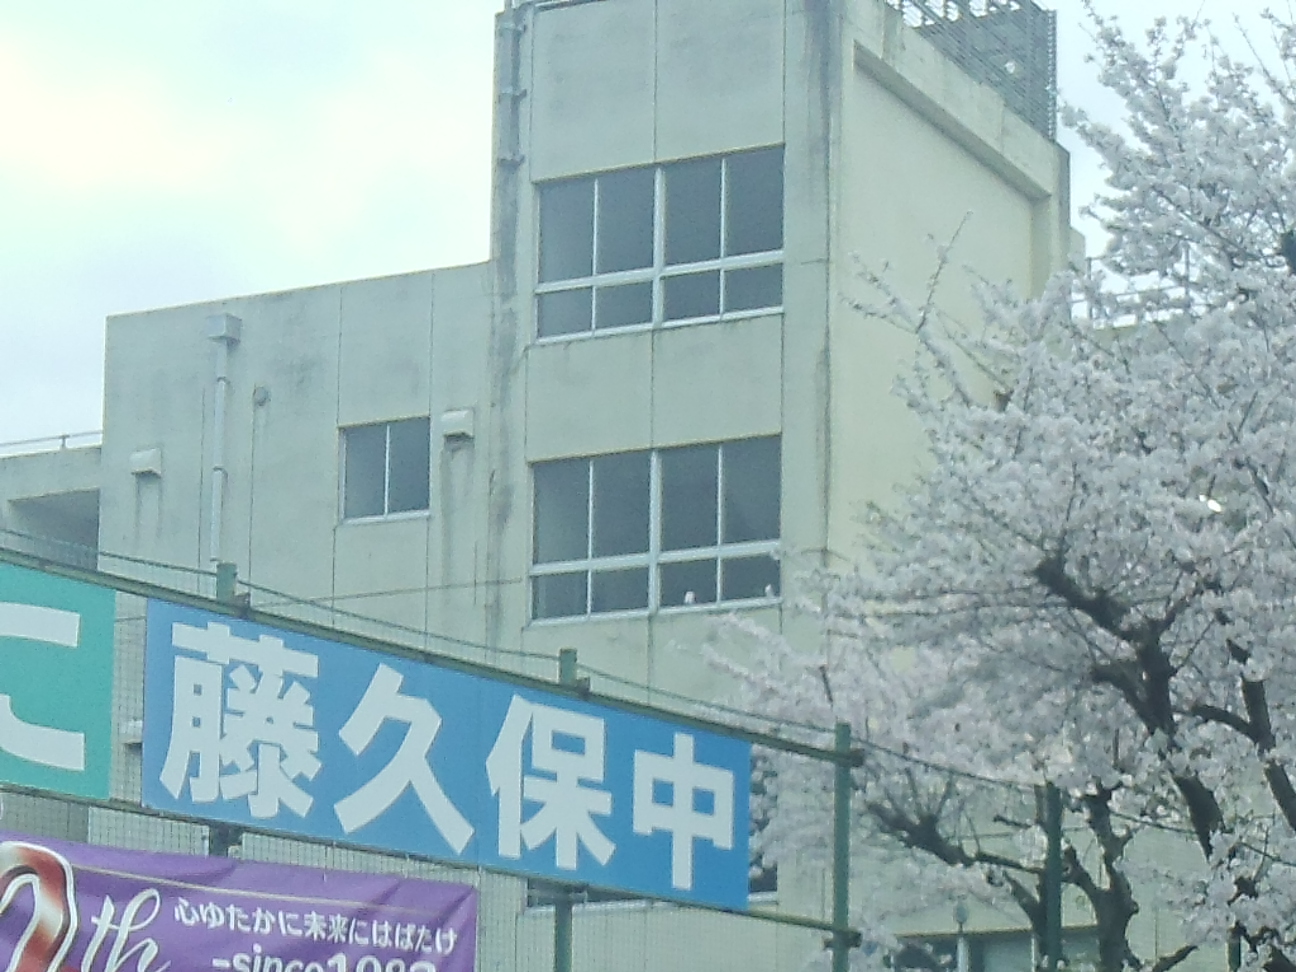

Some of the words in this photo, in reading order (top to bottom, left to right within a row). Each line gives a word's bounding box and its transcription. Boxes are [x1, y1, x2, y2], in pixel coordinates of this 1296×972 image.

[159, 620, 735, 891] 藤久保中
[174, 896, 458, 955] 心ゆたかに未来にはばたけ
